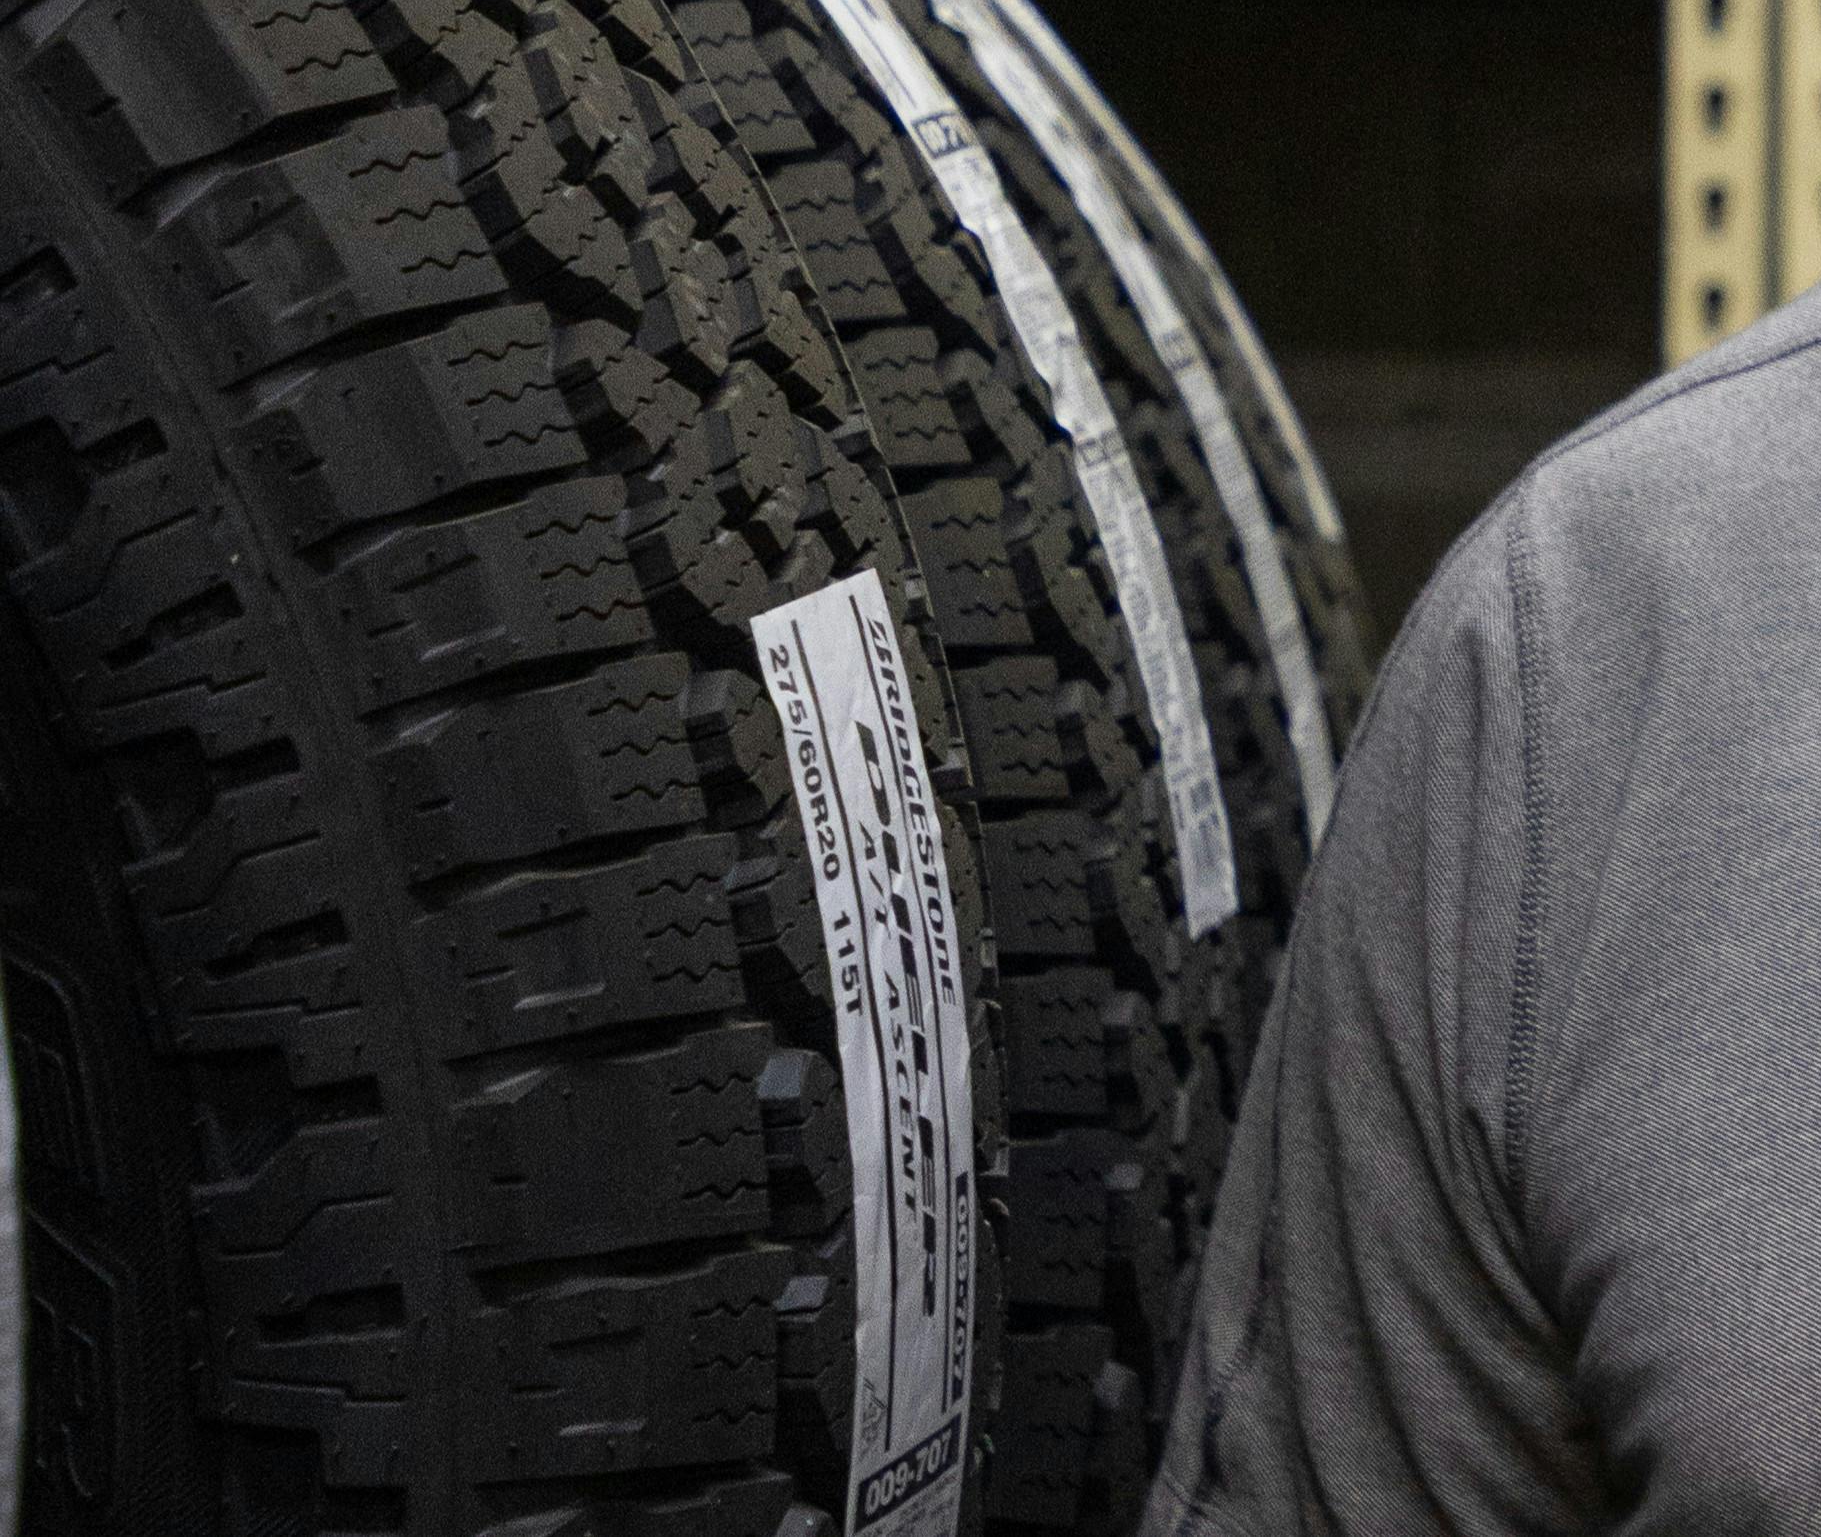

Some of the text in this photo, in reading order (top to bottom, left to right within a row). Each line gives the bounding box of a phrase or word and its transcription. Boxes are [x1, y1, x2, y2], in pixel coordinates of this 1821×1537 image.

[768, 643, 864, 1017] 275/60R20 115T
[866, 616, 957, 1008] BRIDGESTONE
[854, 720, 936, 1317] DUELER
[858, 819, 918, 1223] A/T ASCENT
[863, 1428, 953, 1517] 009-707
